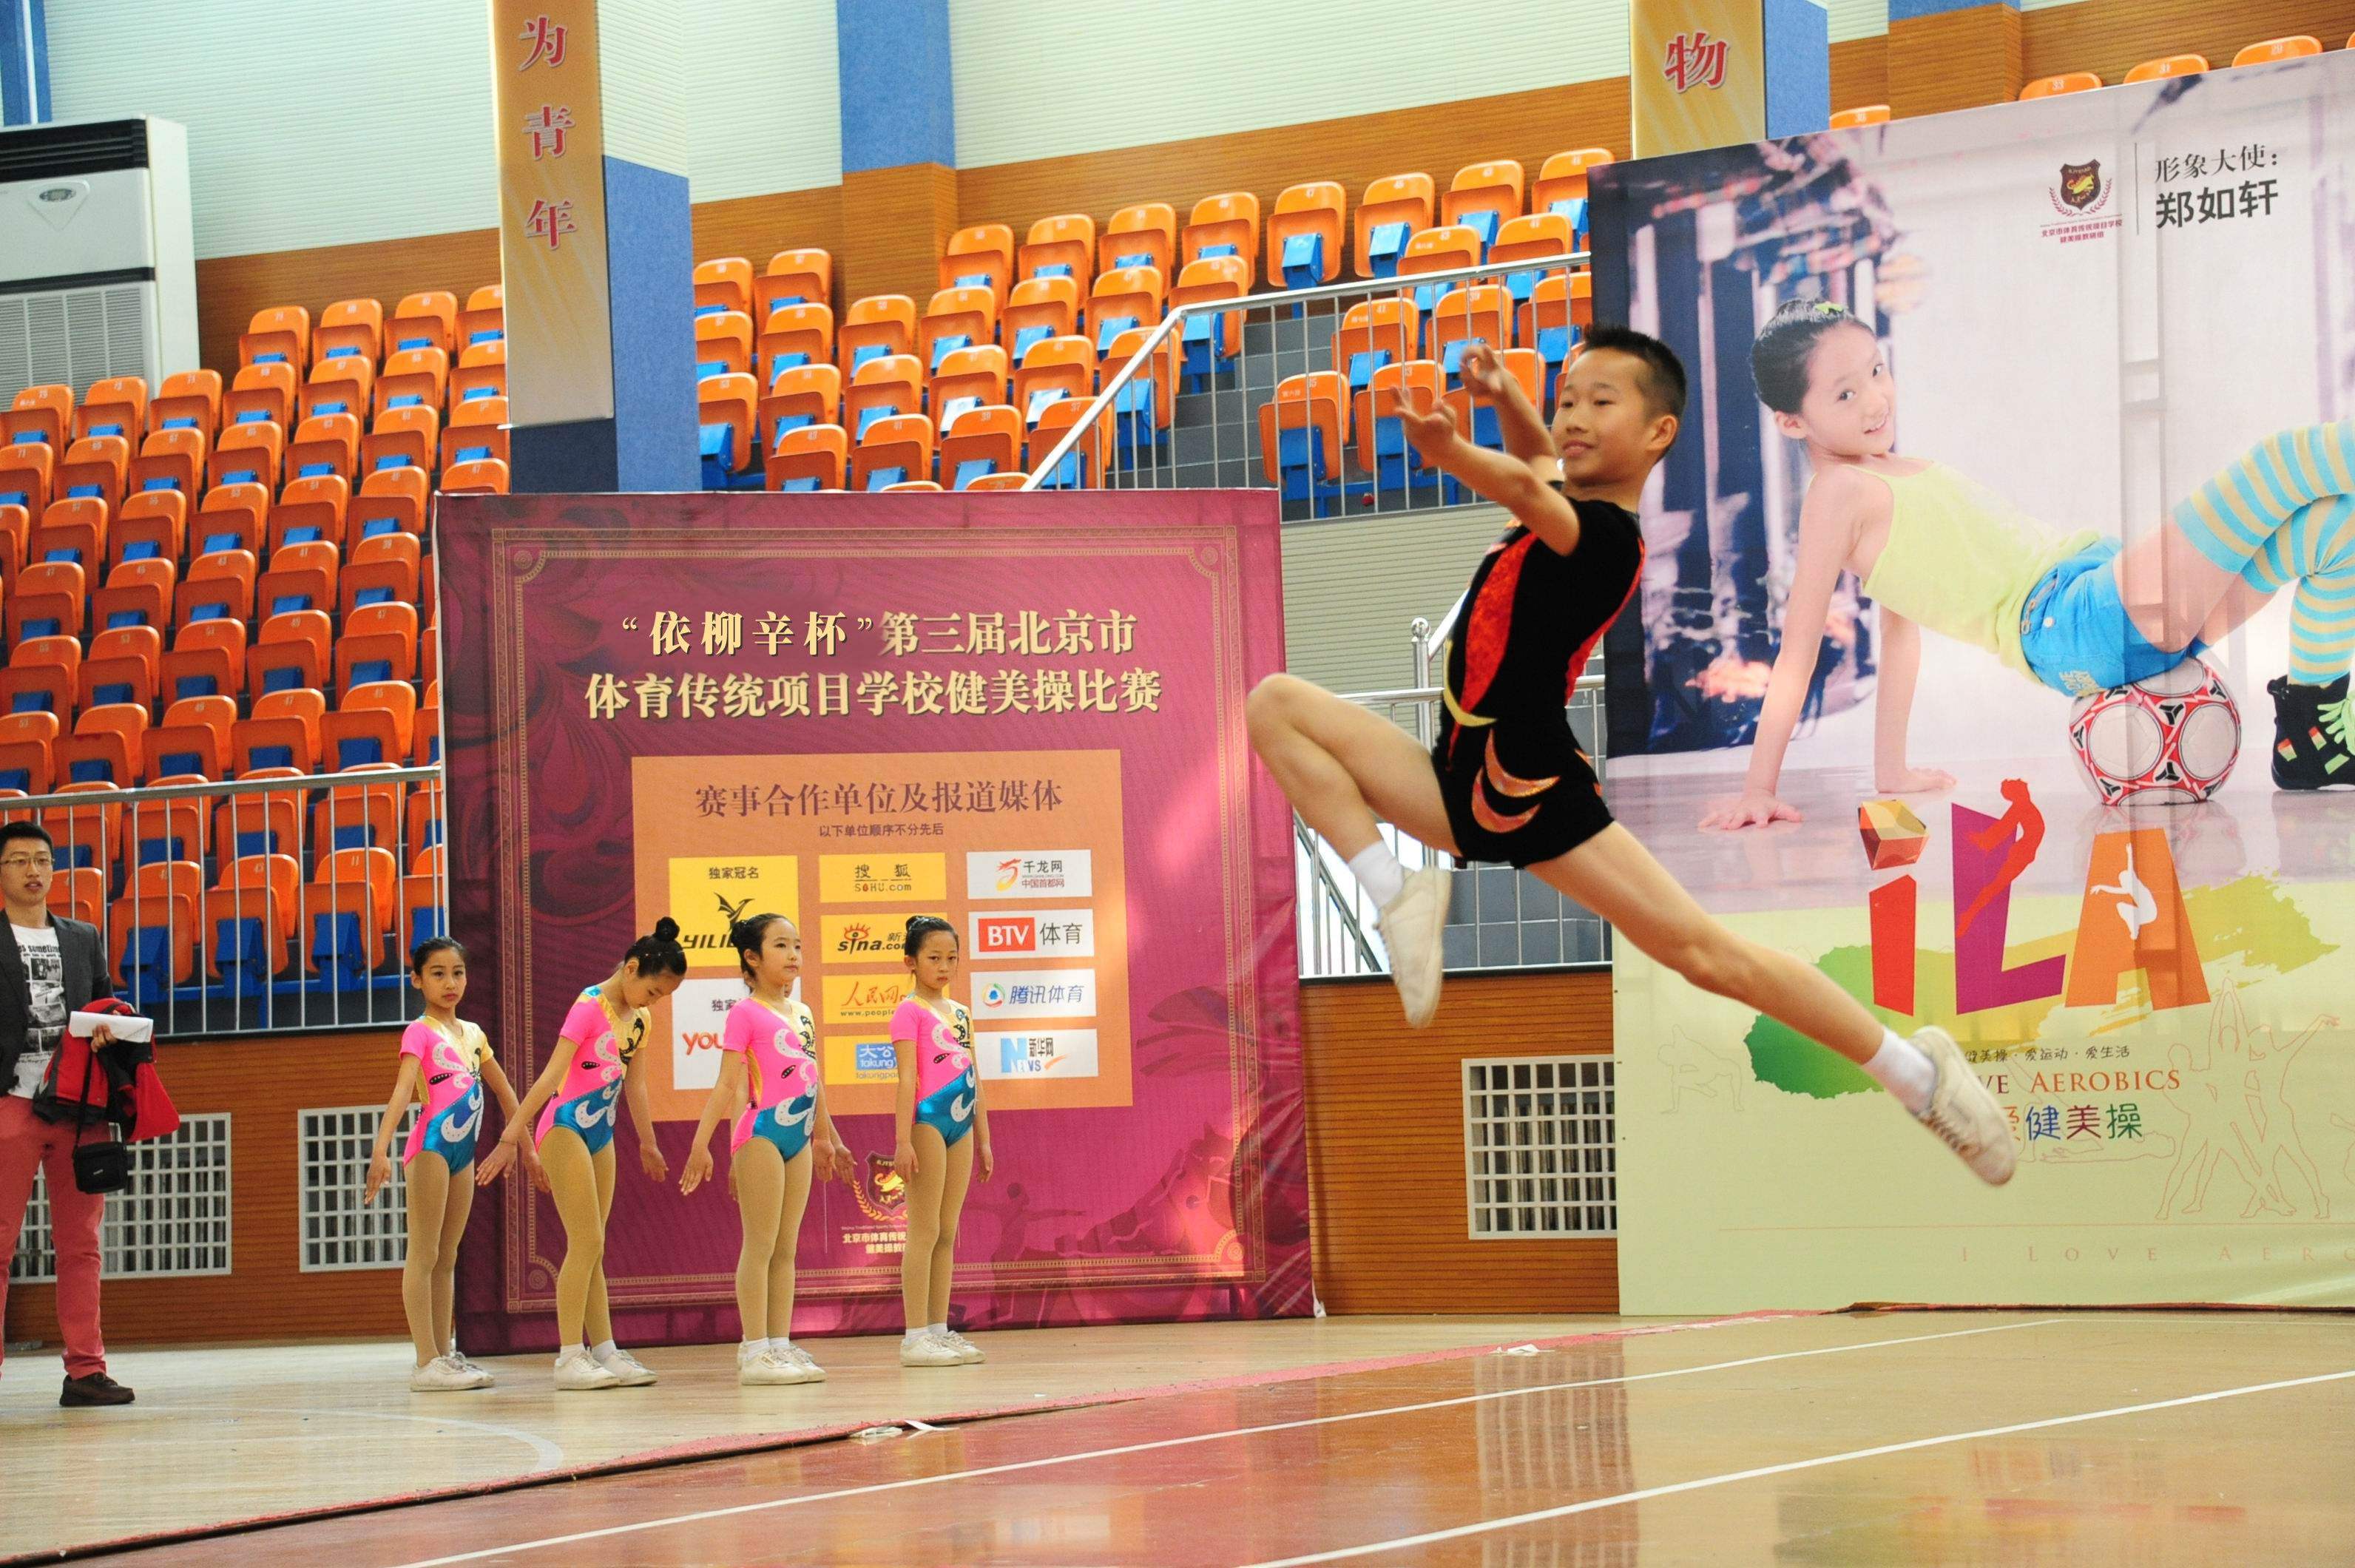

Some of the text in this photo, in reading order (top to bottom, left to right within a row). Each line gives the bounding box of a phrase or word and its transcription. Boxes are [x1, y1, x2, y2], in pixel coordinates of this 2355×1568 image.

[1663, 30, 1728, 94] 物
[518, 15, 577, 251] 为青年
[2156, 178, 2279, 229] 郑如轩
[622, 608, 1137, 657] “依柳辛杯”第三届北京市
[585, 666, 1162, 720] 体育传统项目学校健美操比赛
[696, 779, 1063, 817] 赛事合作单位及报道媒体
[819, 822, 945, 837] 以下单位顺序不分先后
[709, 866, 760, 879] 独家冠名
[1023, 859, 1063, 873] 千龙网
[1021, 878, 1065, 889] 中国首都网
[887, 932, 907, 942] 新
[987, 922, 1083, 947] BTV 体育
[1009, 984, 1084, 1005] 腾讯体育
[1029, 1037, 1054, 1058] 新华网
[2030, 1069, 2180, 1094] AEROBICS
[2029, 1246, 2158, 1263] LOVE
